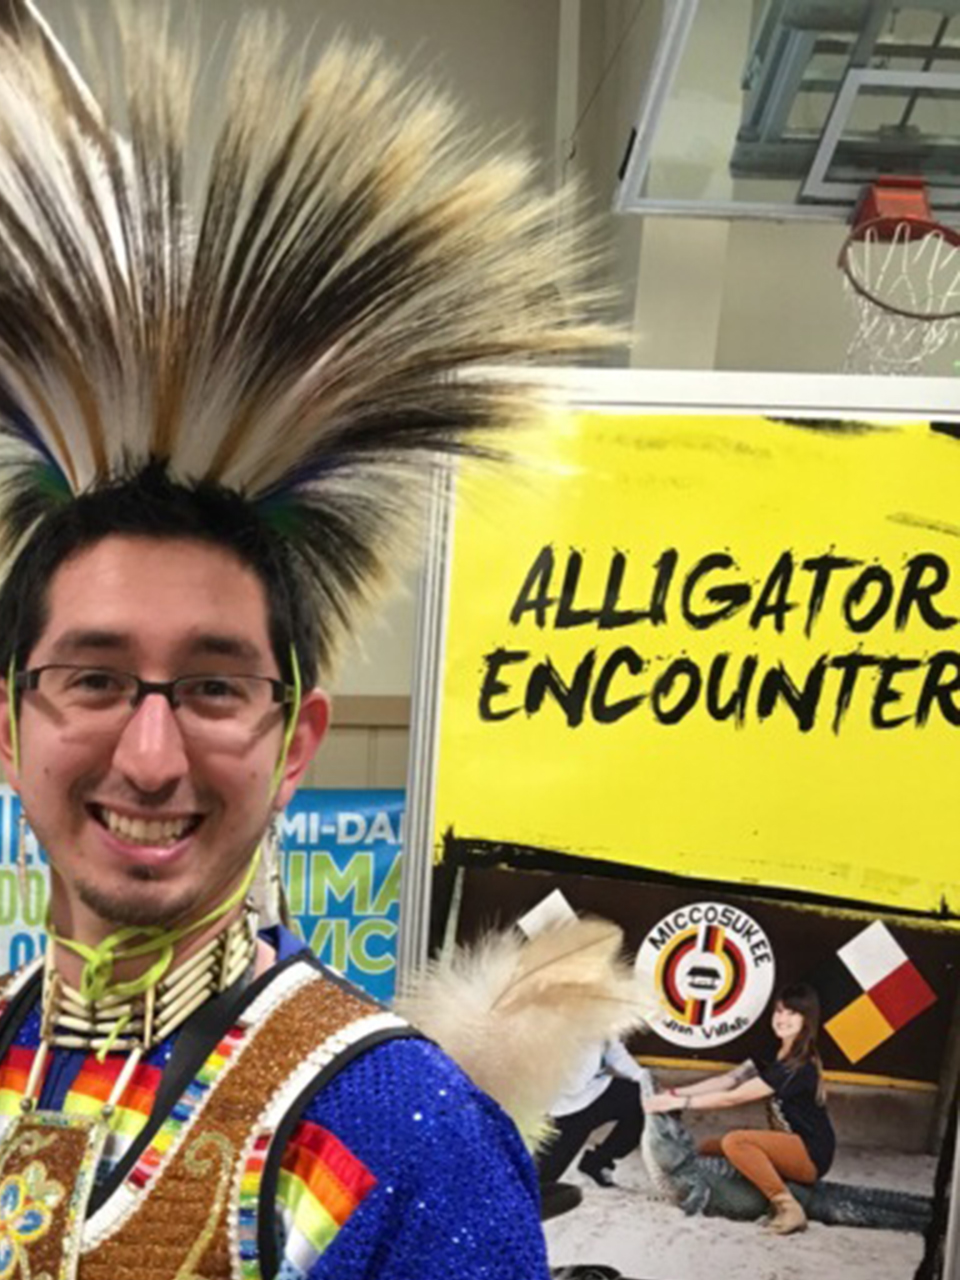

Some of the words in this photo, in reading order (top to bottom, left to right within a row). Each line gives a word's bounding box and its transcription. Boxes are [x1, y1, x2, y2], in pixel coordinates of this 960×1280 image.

[510, 544, 960, 638] ALLIGATOR
[478, 645, 960, 735] ENCOUNTER
[279, 811, 404, 845] MI-DA
[648, 906, 771, 969] MICCOSUKEE
